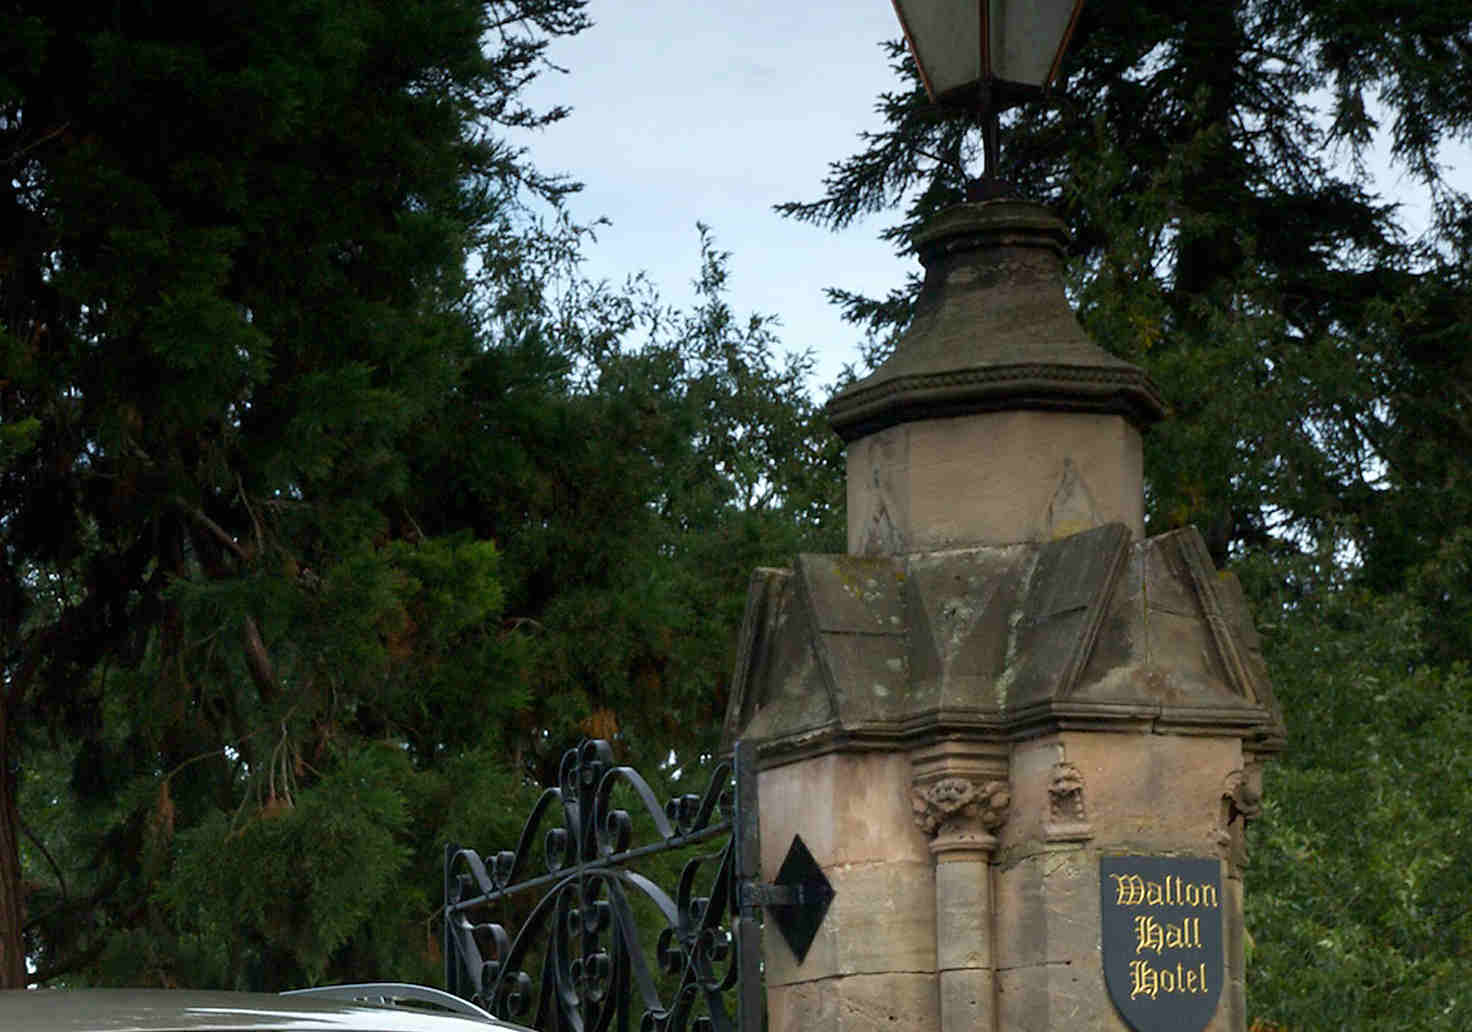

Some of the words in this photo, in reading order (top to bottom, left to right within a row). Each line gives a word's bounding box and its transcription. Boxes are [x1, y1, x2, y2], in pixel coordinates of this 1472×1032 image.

[1110, 873, 1219, 908] Walton
[1134, 915, 1204, 955] Hall
[1129, 959, 1209, 1001] Hotel
